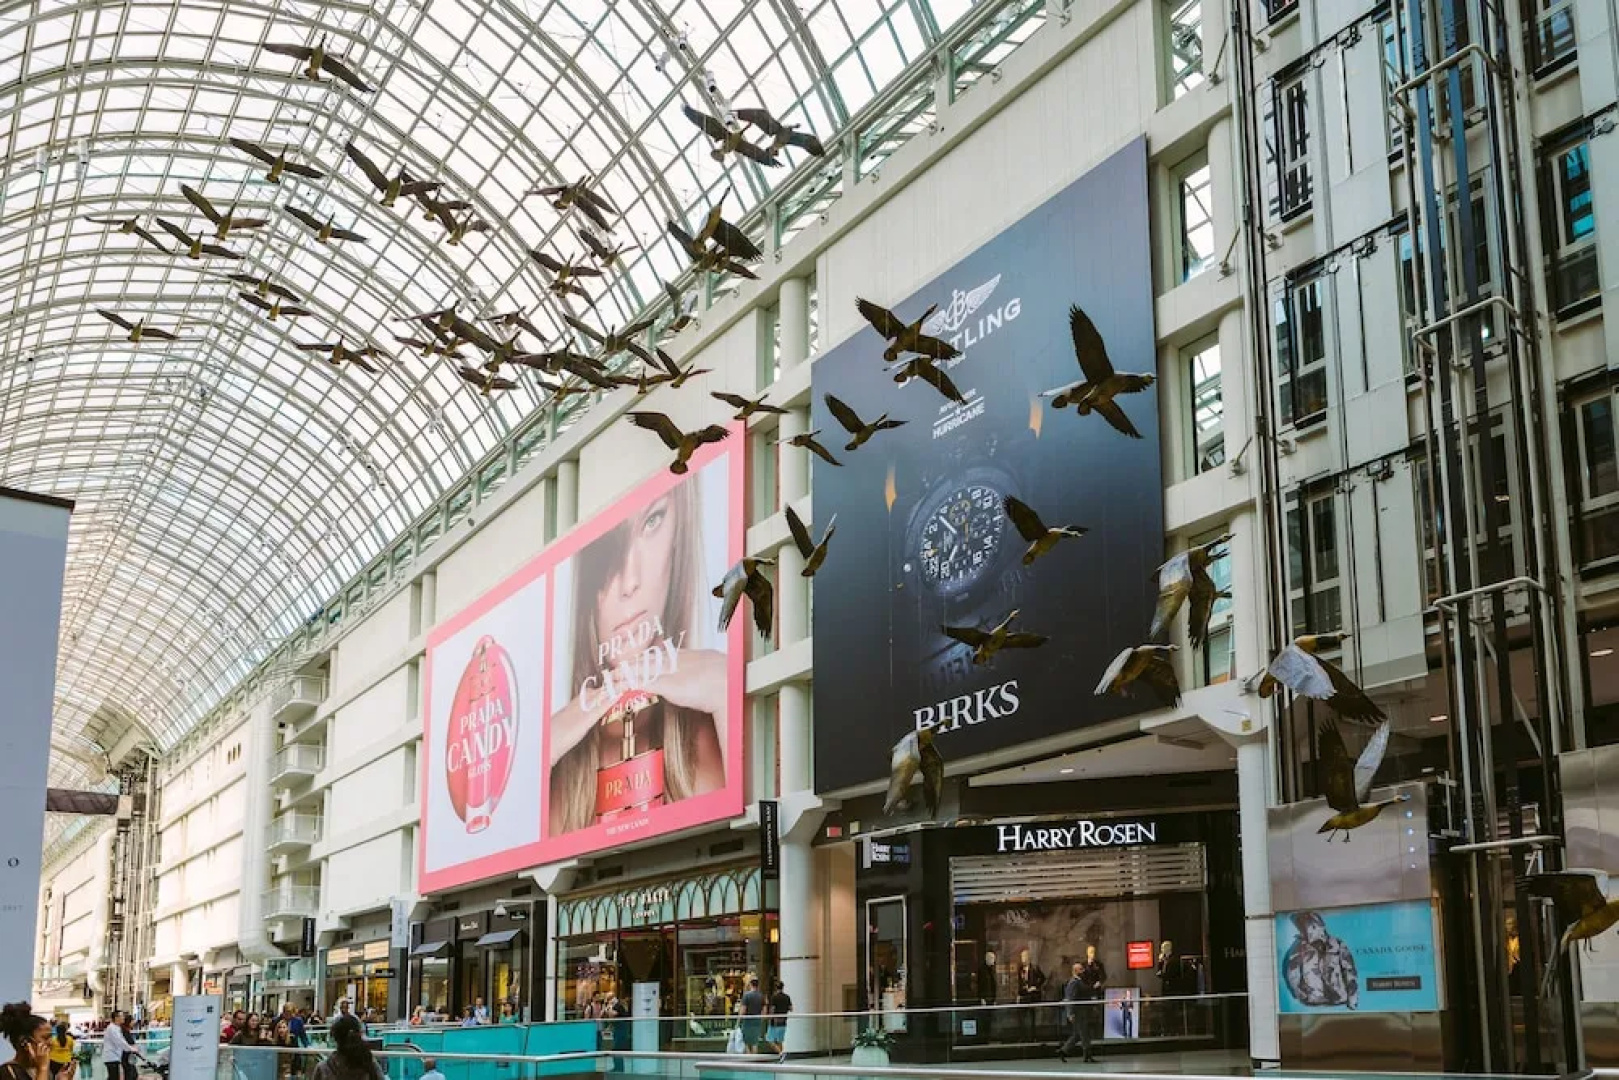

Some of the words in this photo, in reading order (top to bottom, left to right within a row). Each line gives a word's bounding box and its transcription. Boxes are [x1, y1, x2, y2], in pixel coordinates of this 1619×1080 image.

[598, 614, 664, 667] PRADA
[580, 629, 687, 712] CANDY
[460, 698, 503, 736] PRADA
[912, 679, 1020, 735] BIRKS
[447, 715, 515, 773] CANDY
[604, 769, 652, 799] PRADA
[996, 824, 1076, 852] HARRY
[1077, 820, 1157, 847] ROSEN
